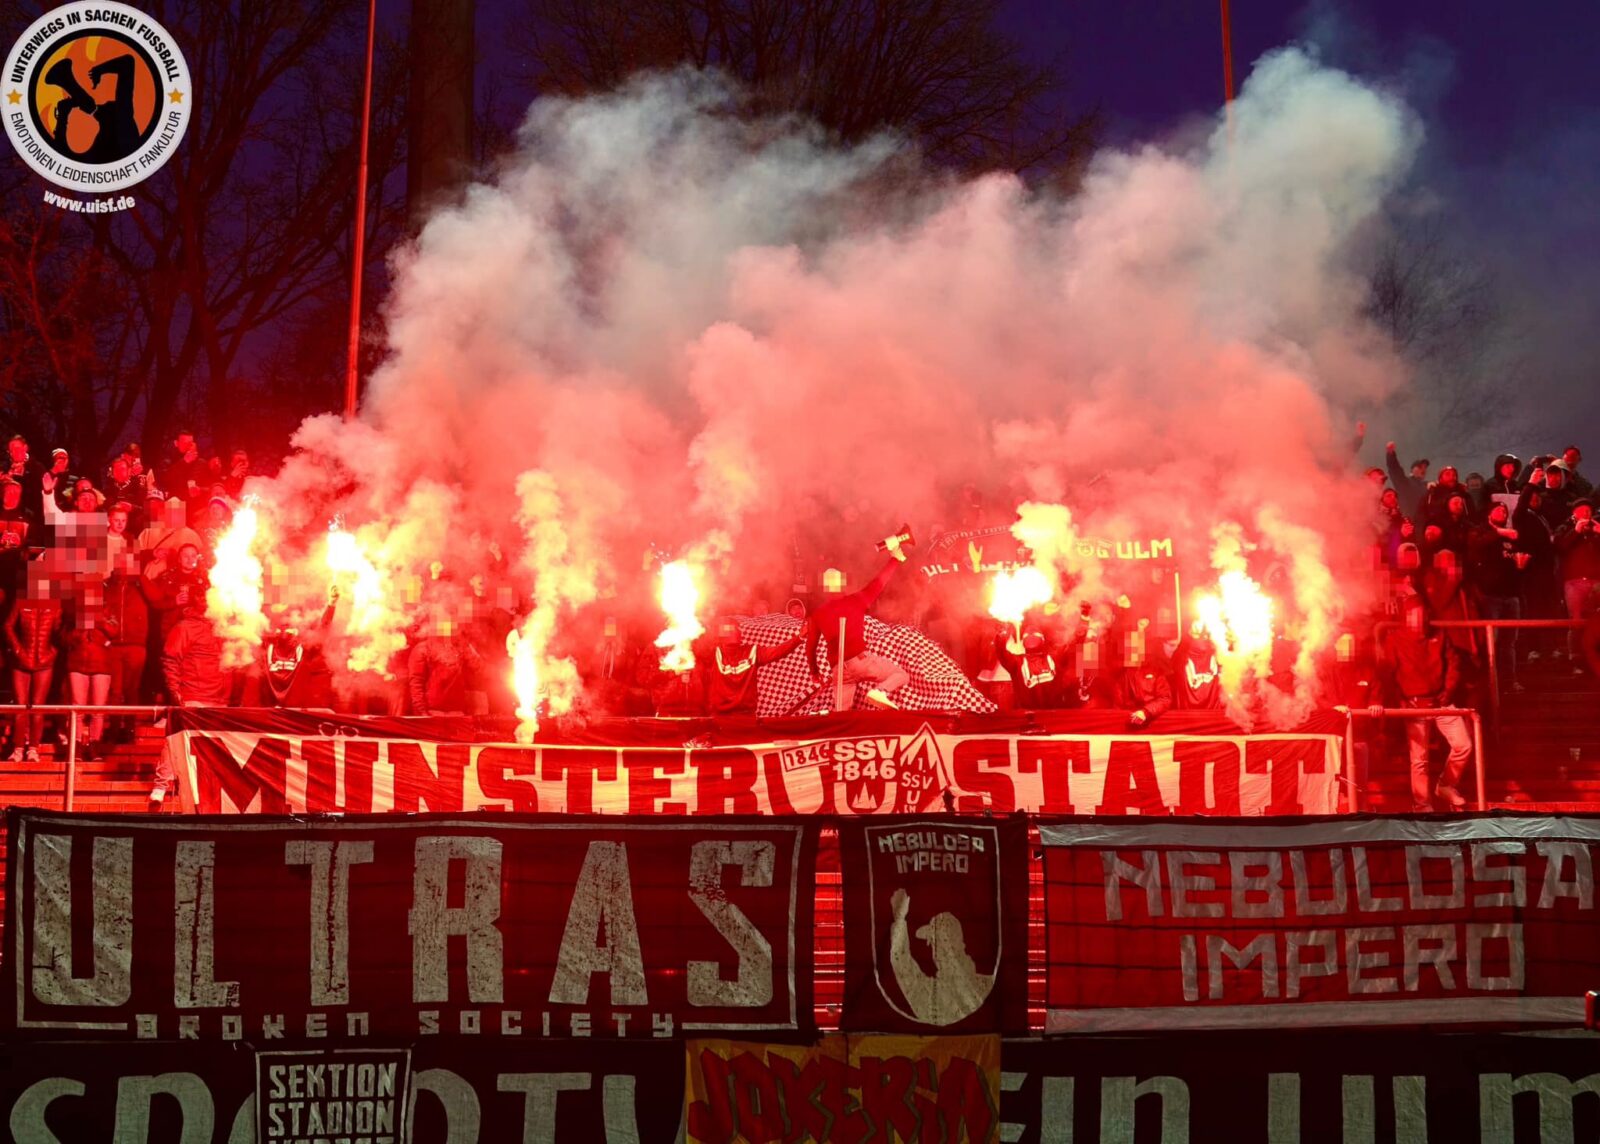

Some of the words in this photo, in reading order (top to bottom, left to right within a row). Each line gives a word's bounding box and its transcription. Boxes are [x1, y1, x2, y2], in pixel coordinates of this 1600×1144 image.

[1116, 538, 1173, 559] ULM
[833, 739, 899, 762] SSV
[833, 759, 897, 781] 1846
[901, 771, 934, 790] SSV
[953, 738, 1327, 815] STADT
[878, 832, 985, 853] NEBULOSA
[895, 851, 969, 874] IMPERO
[1101, 842, 1595, 921] NEBULOSA
[31, 834, 776, 1008] ULTRAS
[1180, 923, 1526, 1001] IMPERO
[419, 1010, 675, 1038] SOCIETY
[269, 1063, 397, 1099] SEKTION
[268, 1100, 395, 1137] STADION
